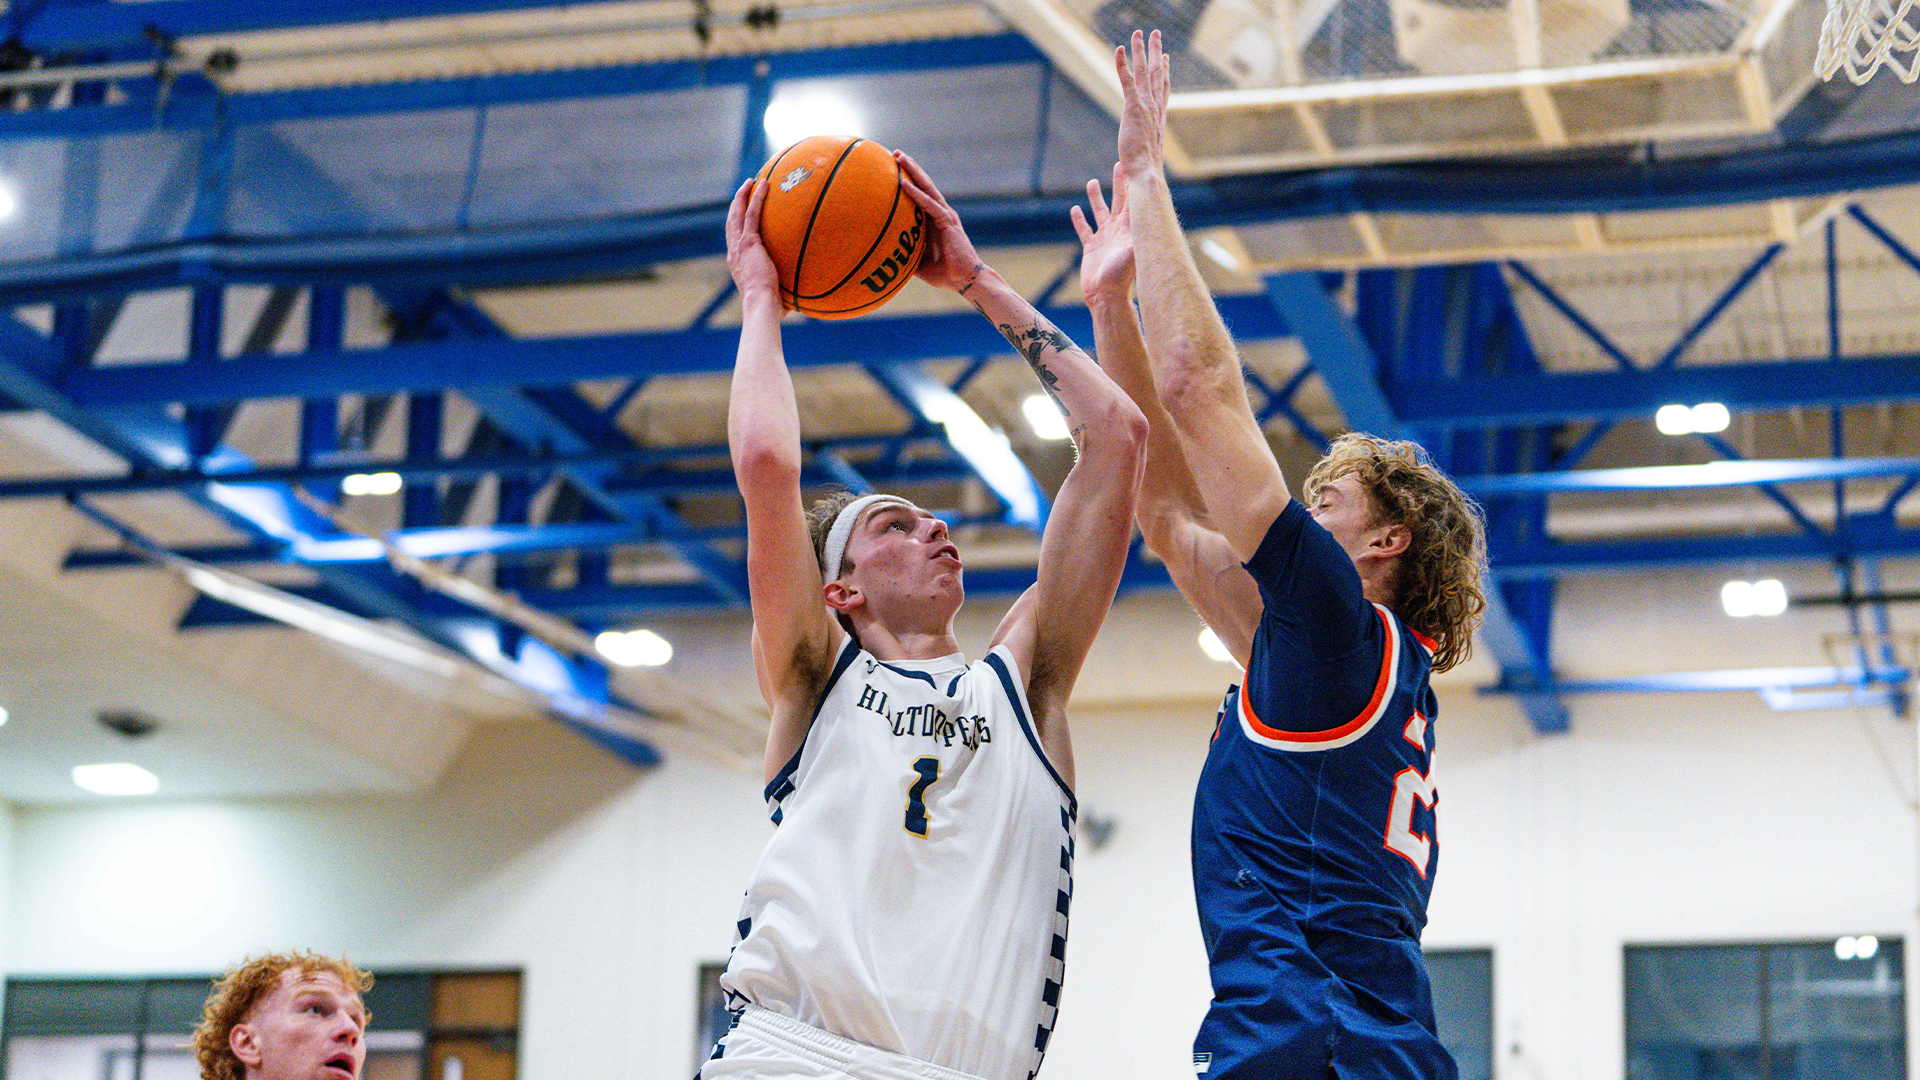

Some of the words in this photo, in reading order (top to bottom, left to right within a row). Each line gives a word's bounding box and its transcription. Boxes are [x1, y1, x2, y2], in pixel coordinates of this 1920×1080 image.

[860, 204, 924, 293] Wilso
[856, 683, 991, 750] HILTOPPES
[903, 755, 941, 840] 1
[1384, 708, 1439, 880] 2
